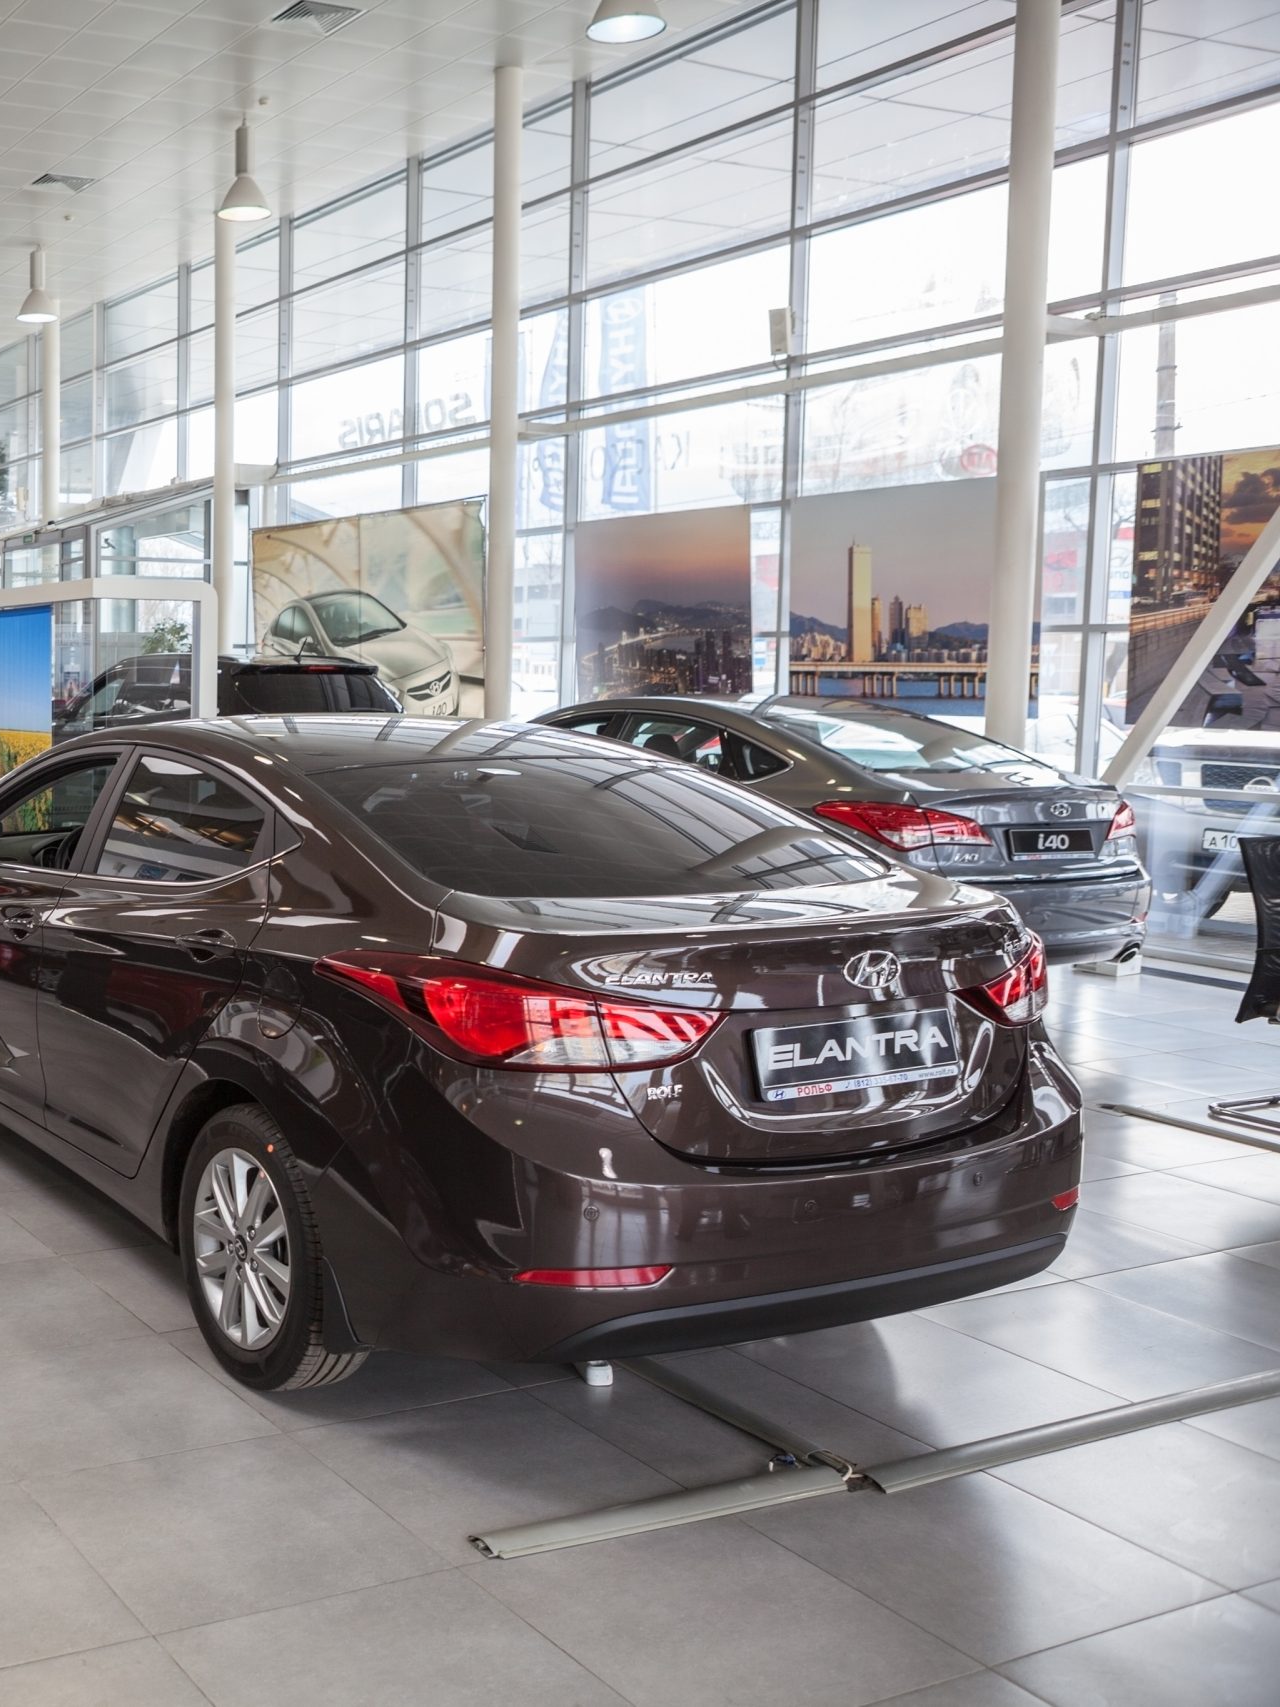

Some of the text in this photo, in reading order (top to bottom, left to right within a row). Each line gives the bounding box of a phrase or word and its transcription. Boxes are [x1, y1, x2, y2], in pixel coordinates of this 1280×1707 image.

[1037, 833, 1070, 850] i40
[604, 971, 713, 986] ELANTRA
[768, 1026, 949, 1070] ELANTRA
[796, 1083, 833, 1097] РОЛЬФ
